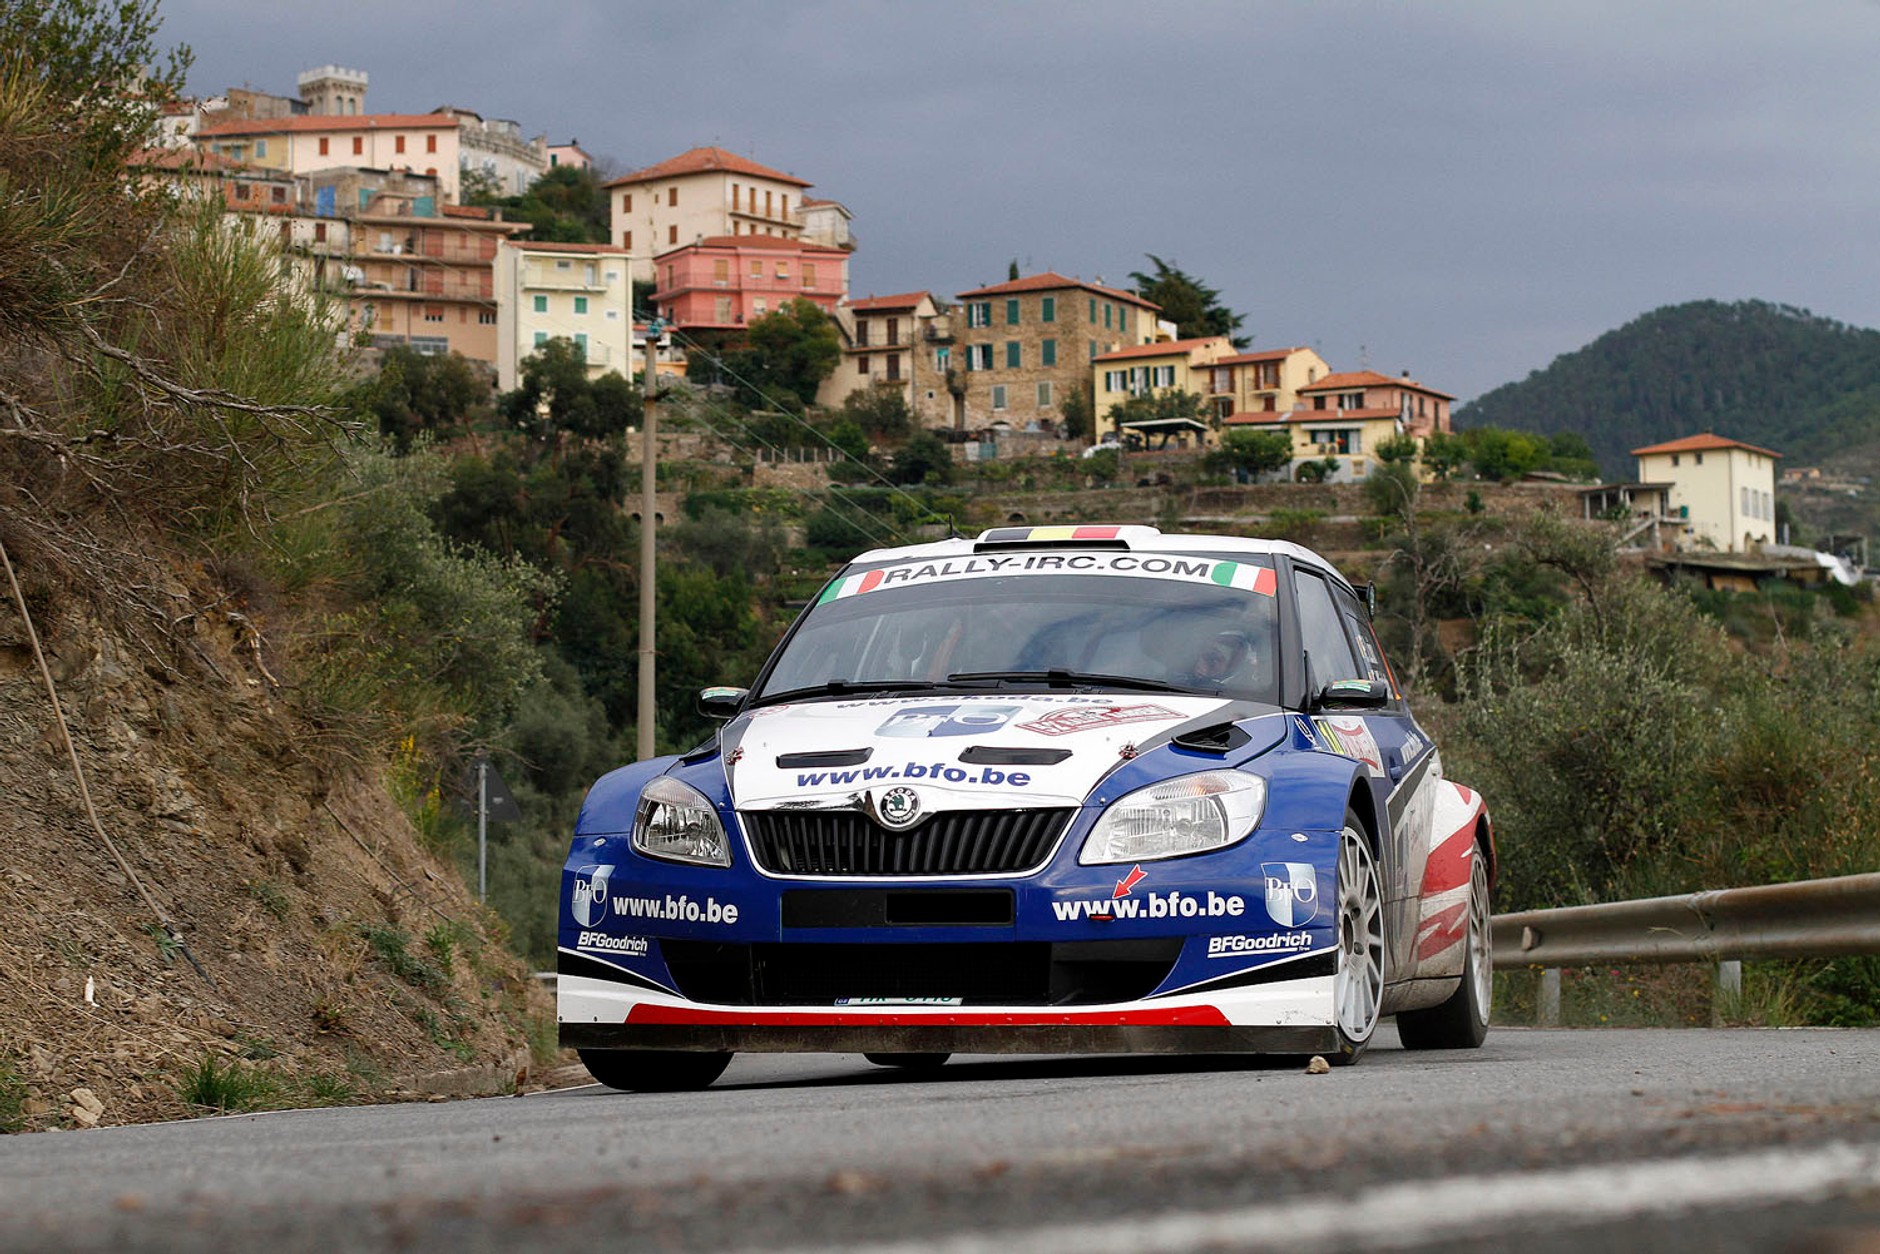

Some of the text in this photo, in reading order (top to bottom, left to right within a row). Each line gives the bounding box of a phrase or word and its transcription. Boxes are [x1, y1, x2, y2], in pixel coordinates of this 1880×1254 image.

[884, 556, 1210, 583] RALLY-IRC.COM
[797, 762, 1031, 786] www.bfo.be
[612, 894, 739, 924] www.bfo.be
[1051, 890, 1245, 921] www.bfo.be
[577, 930, 648, 952] BFGoodrich
[1208, 930, 1313, 953] BFGoodrich
